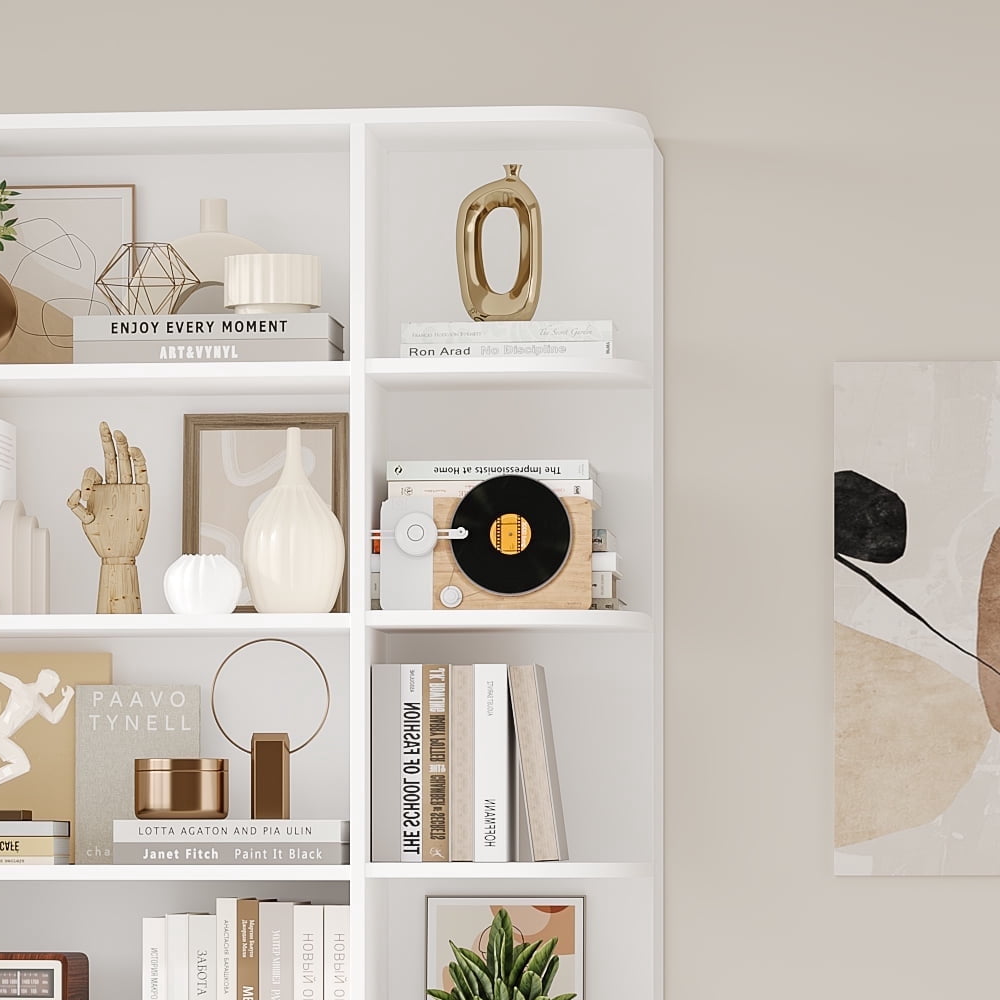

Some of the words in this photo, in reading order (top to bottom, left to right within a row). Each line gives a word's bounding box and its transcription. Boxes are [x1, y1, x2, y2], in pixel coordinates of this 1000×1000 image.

[110, 320, 161, 335] ENJOY
[166, 320, 214, 335] EVERY
[221, 320, 288, 335] MOMENT
[159, 345, 238, 360] ART&VYNYL
[409, 348, 435, 356] Ron
[440, 347, 471, 356] Arad
[434, 465, 460, 474] Home
[463, 466, 472, 474] at
[475, 466, 542, 476] Impressionists
[545, 466, 561, 474] The
[93, 691, 186, 708] PAAVO
[89, 714, 191, 731] TYNELL
[138, 826, 175, 836] LOTTA
[181, 826, 228, 836] AGATON
[234, 826, 257, 836] AND
[263, 826, 281, 836] PIA
[286, 826, 312, 836] ULIN
[143, 848, 179, 860] Janet
[186, 848, 219, 860] Fitch
[234, 848, 268, 860] Paint
[274, 848, 283, 860] It
[289, 848, 322, 860] Black
[302, 933, 315, 984] НОВЫЙ
[333, 933, 346, 984] НОВЫЙ
[195, 950, 208, 996] ЗАБОТА
